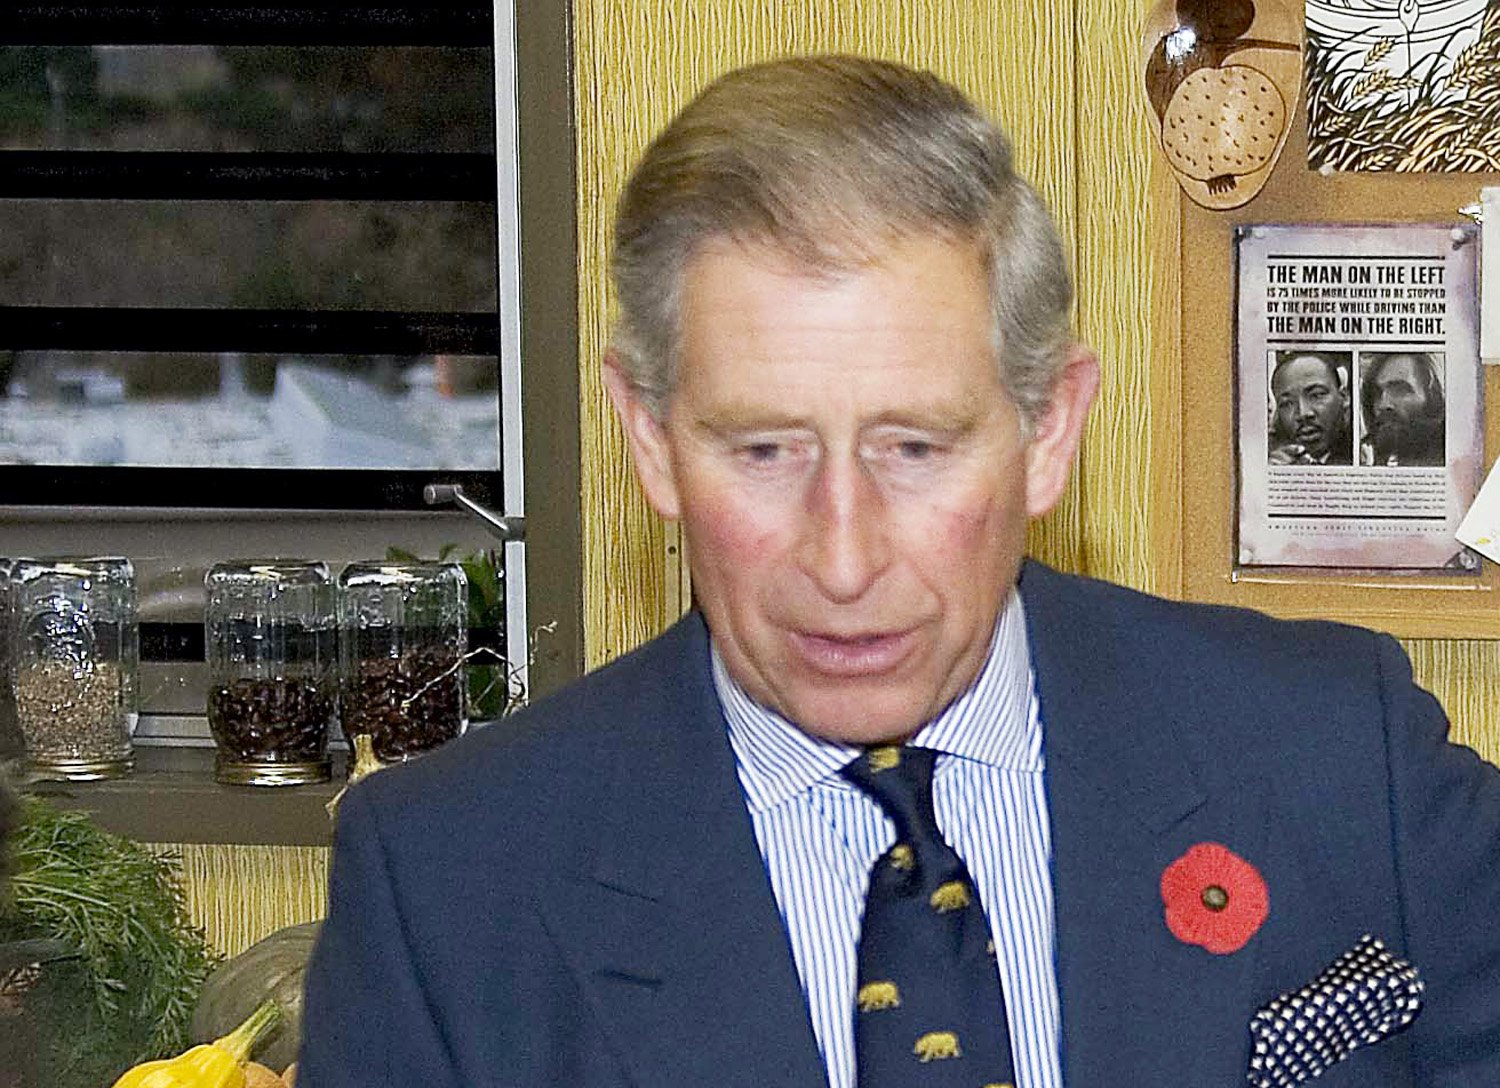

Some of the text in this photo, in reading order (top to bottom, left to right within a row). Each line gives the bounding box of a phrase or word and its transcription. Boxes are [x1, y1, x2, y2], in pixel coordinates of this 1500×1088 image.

[1267, 265, 1446, 284] THE MAN ON THE LEFT
[1266, 287, 1446, 299] IS 75 TIMES MORE LIKELY TO BE STOPPED
[1267, 301, 1446, 314] BY THE POLICE WHILE DRIVING THAN
[1267, 316, 1446, 335] THE MAN ON THE RIGHT.
